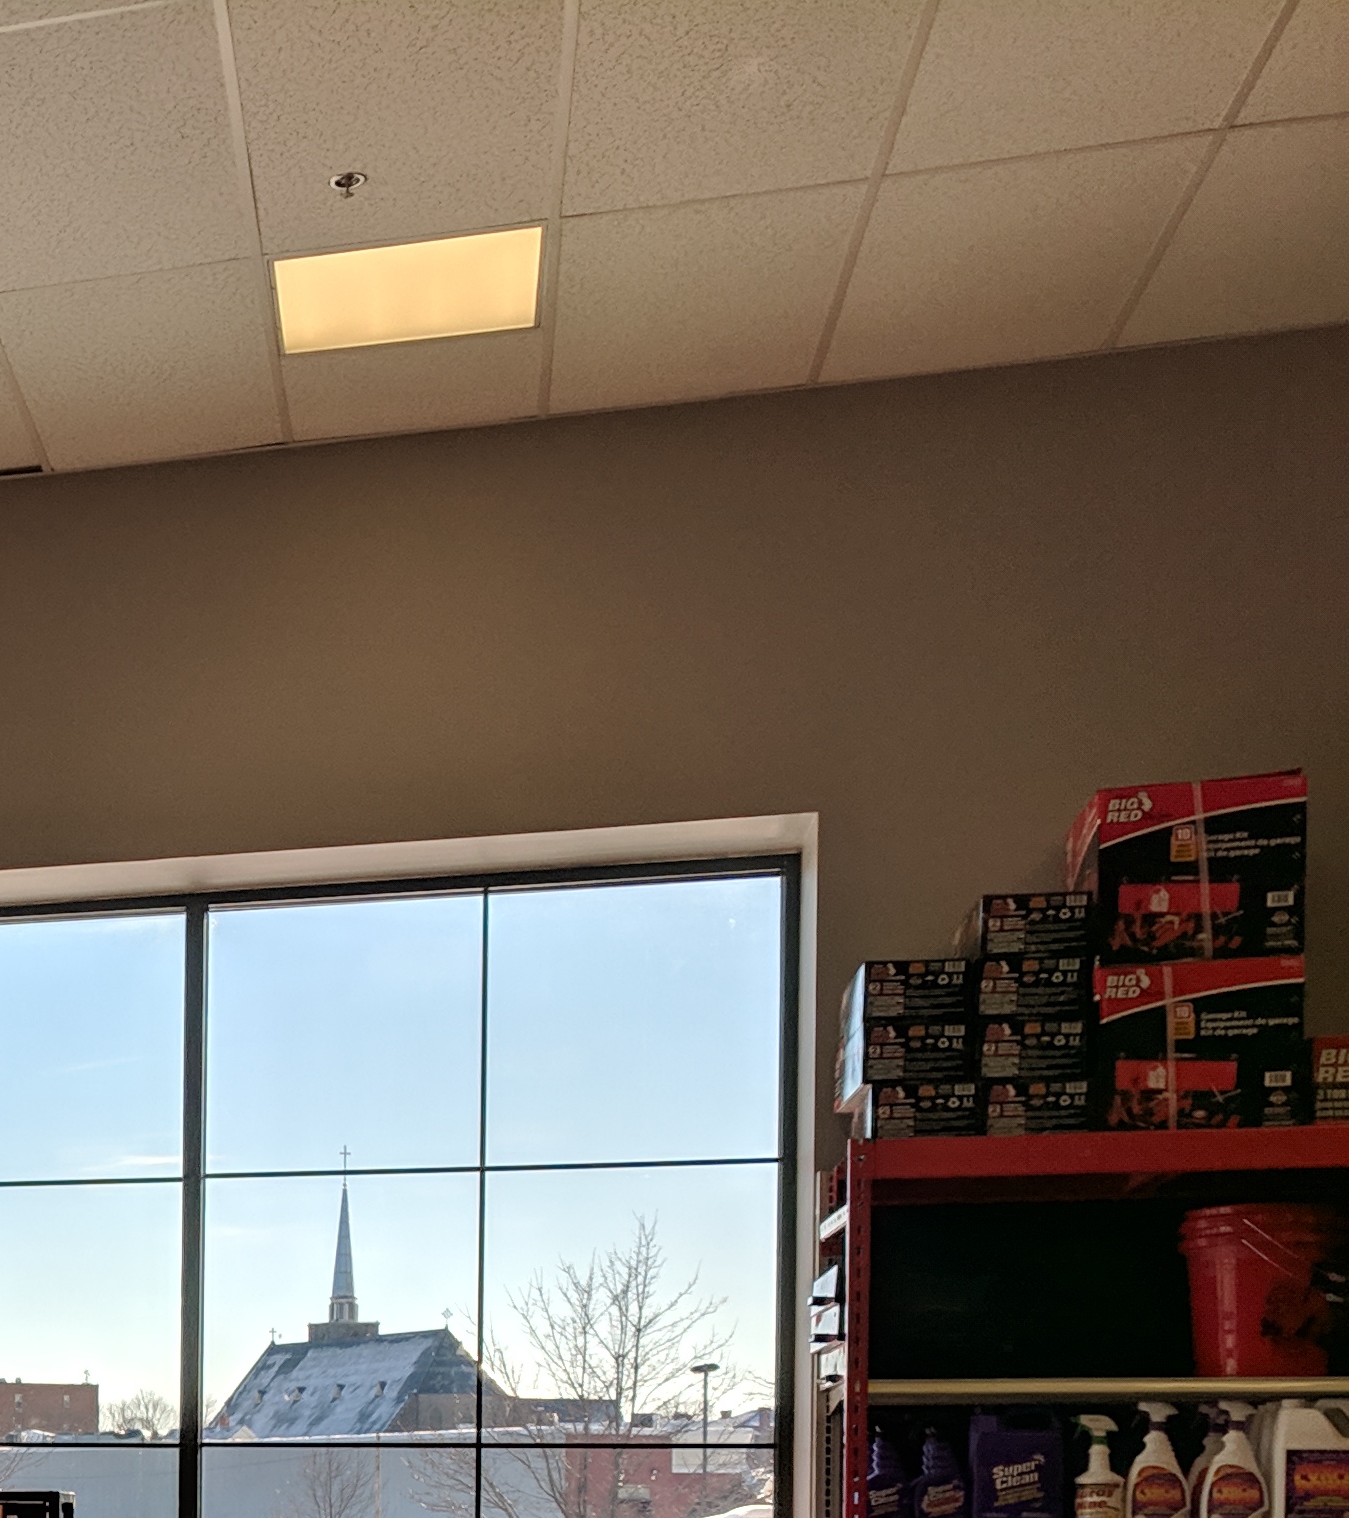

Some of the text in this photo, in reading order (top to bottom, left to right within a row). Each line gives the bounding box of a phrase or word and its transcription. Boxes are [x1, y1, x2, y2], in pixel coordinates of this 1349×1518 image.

[1107, 797, 1139, 811] BIG
[1106, 810, 1143, 824] RED
[1106, 974, 1137, 987] BIG
[1105, 986, 1141, 999] RED
[991, 1460, 1038, 1478] Super
[995, 1472, 1039, 1490] Clean
